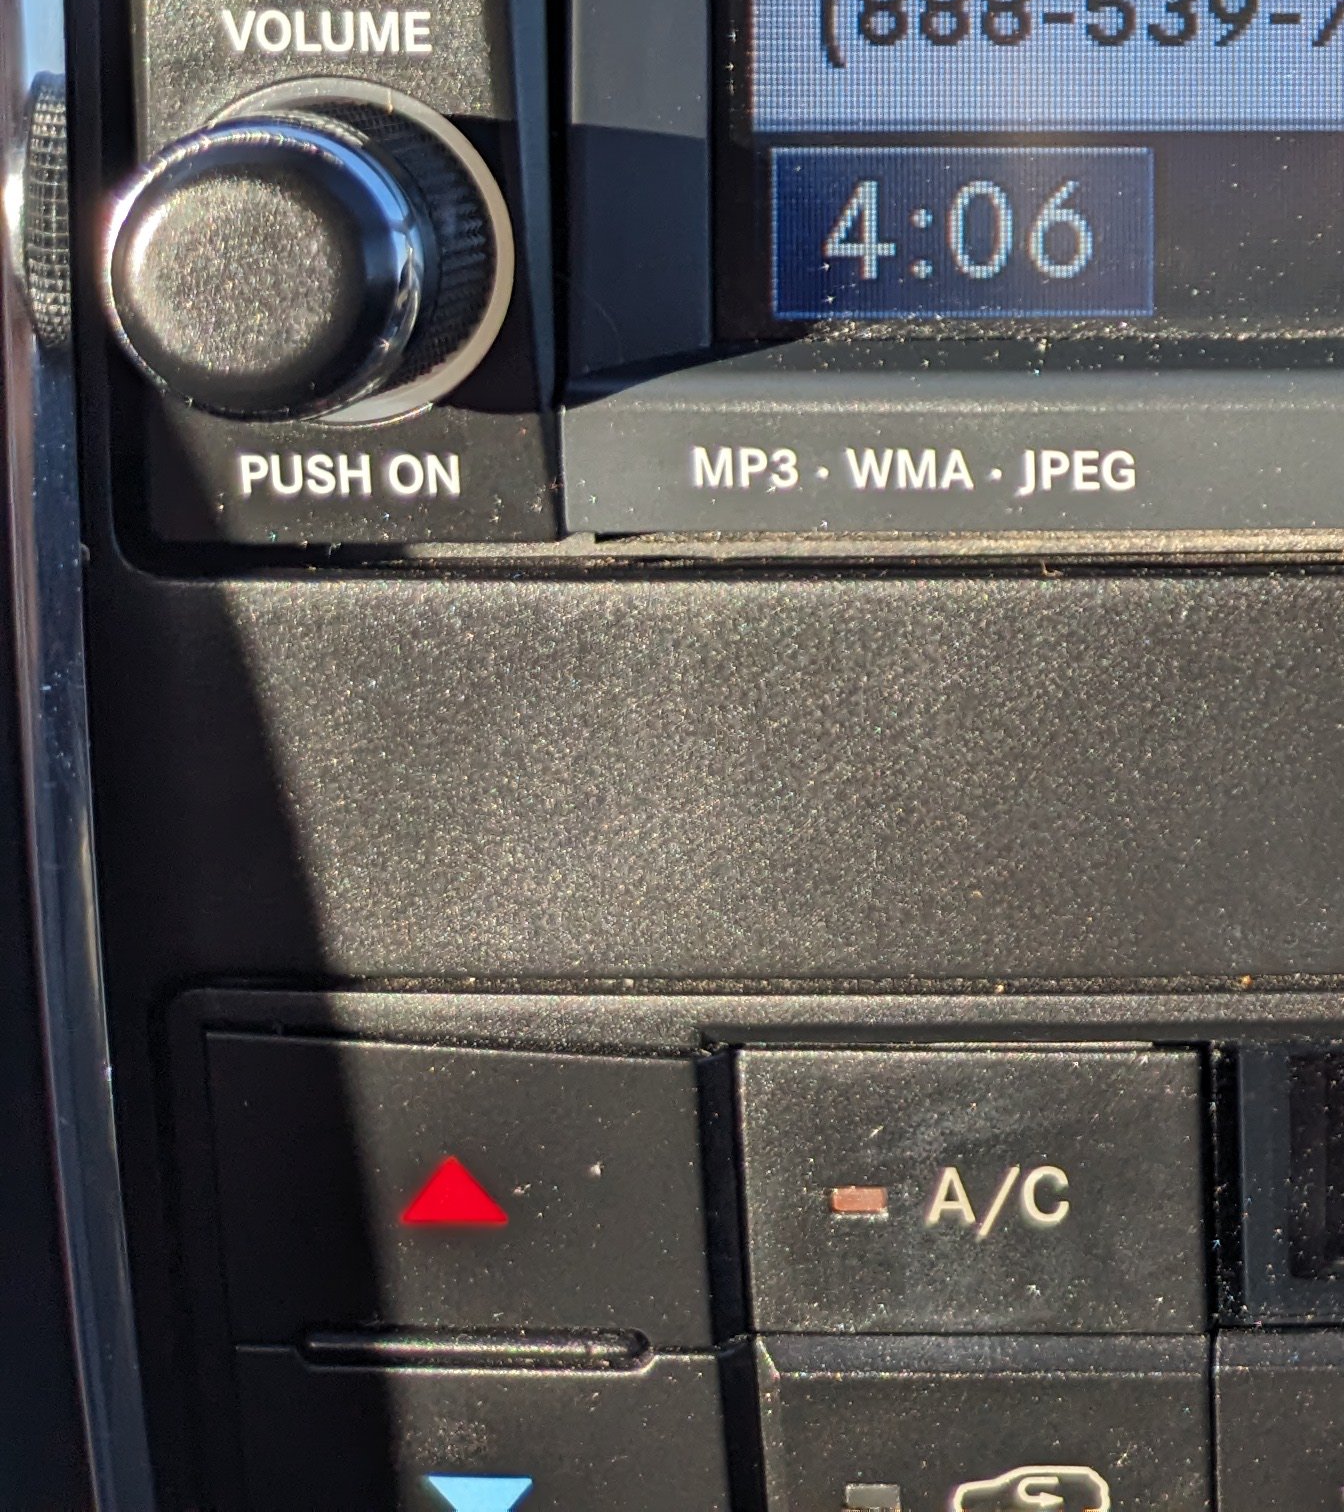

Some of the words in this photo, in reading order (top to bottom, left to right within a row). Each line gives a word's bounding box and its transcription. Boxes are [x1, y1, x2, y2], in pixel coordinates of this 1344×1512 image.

[220, 8, 433, 55] VOLUME
[824, 180, 1094, 280] 4:06
[241, 453, 369, 496] PUSH
[388, 453, 460, 496] ON
[692, 445, 799, 490] MP3
[845, 447, 974, 492] WMA
[1016, 449, 1138, 498] JPEG
[927, 1165, 1066, 1238] A/C
